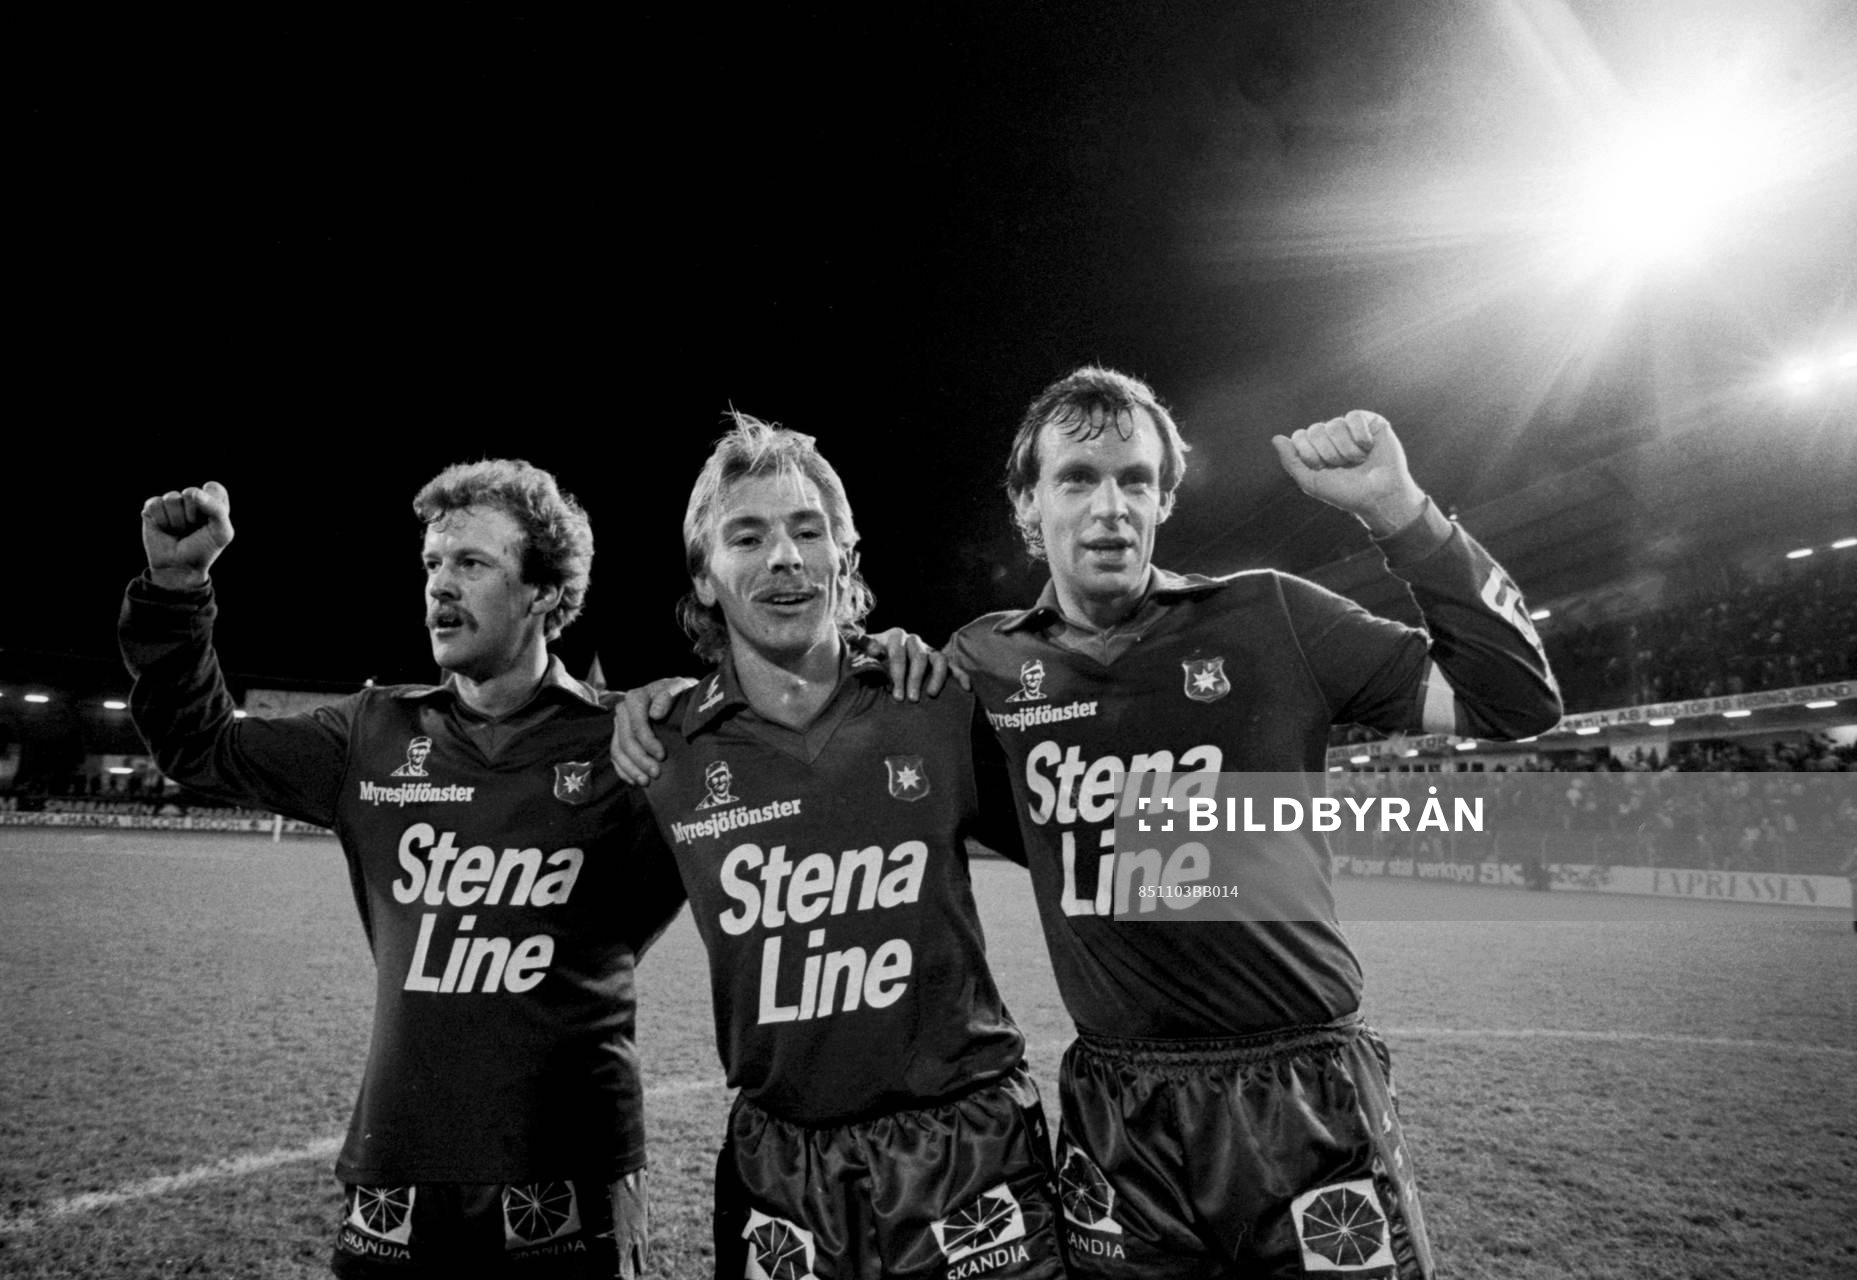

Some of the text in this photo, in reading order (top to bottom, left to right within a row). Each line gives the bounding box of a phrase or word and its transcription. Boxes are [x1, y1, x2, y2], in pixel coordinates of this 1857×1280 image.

[360, 781, 475, 807] Myresjöfönster
[671, 799, 801, 845] Myresjöfönster
[1027, 740, 1222, 825] Stena
[393, 823, 584, 907] Stena
[718, 840, 929, 936] Stena
[1061, 829, 1211, 917] Line
[1479, 862, 1525, 885] SK
[403, 913, 555, 993] Line
[757, 928, 913, 1025] Line
[947, 1245, 1030, 1280] SKANDIA
[1066, 1232, 1126, 1260] ANDIA
